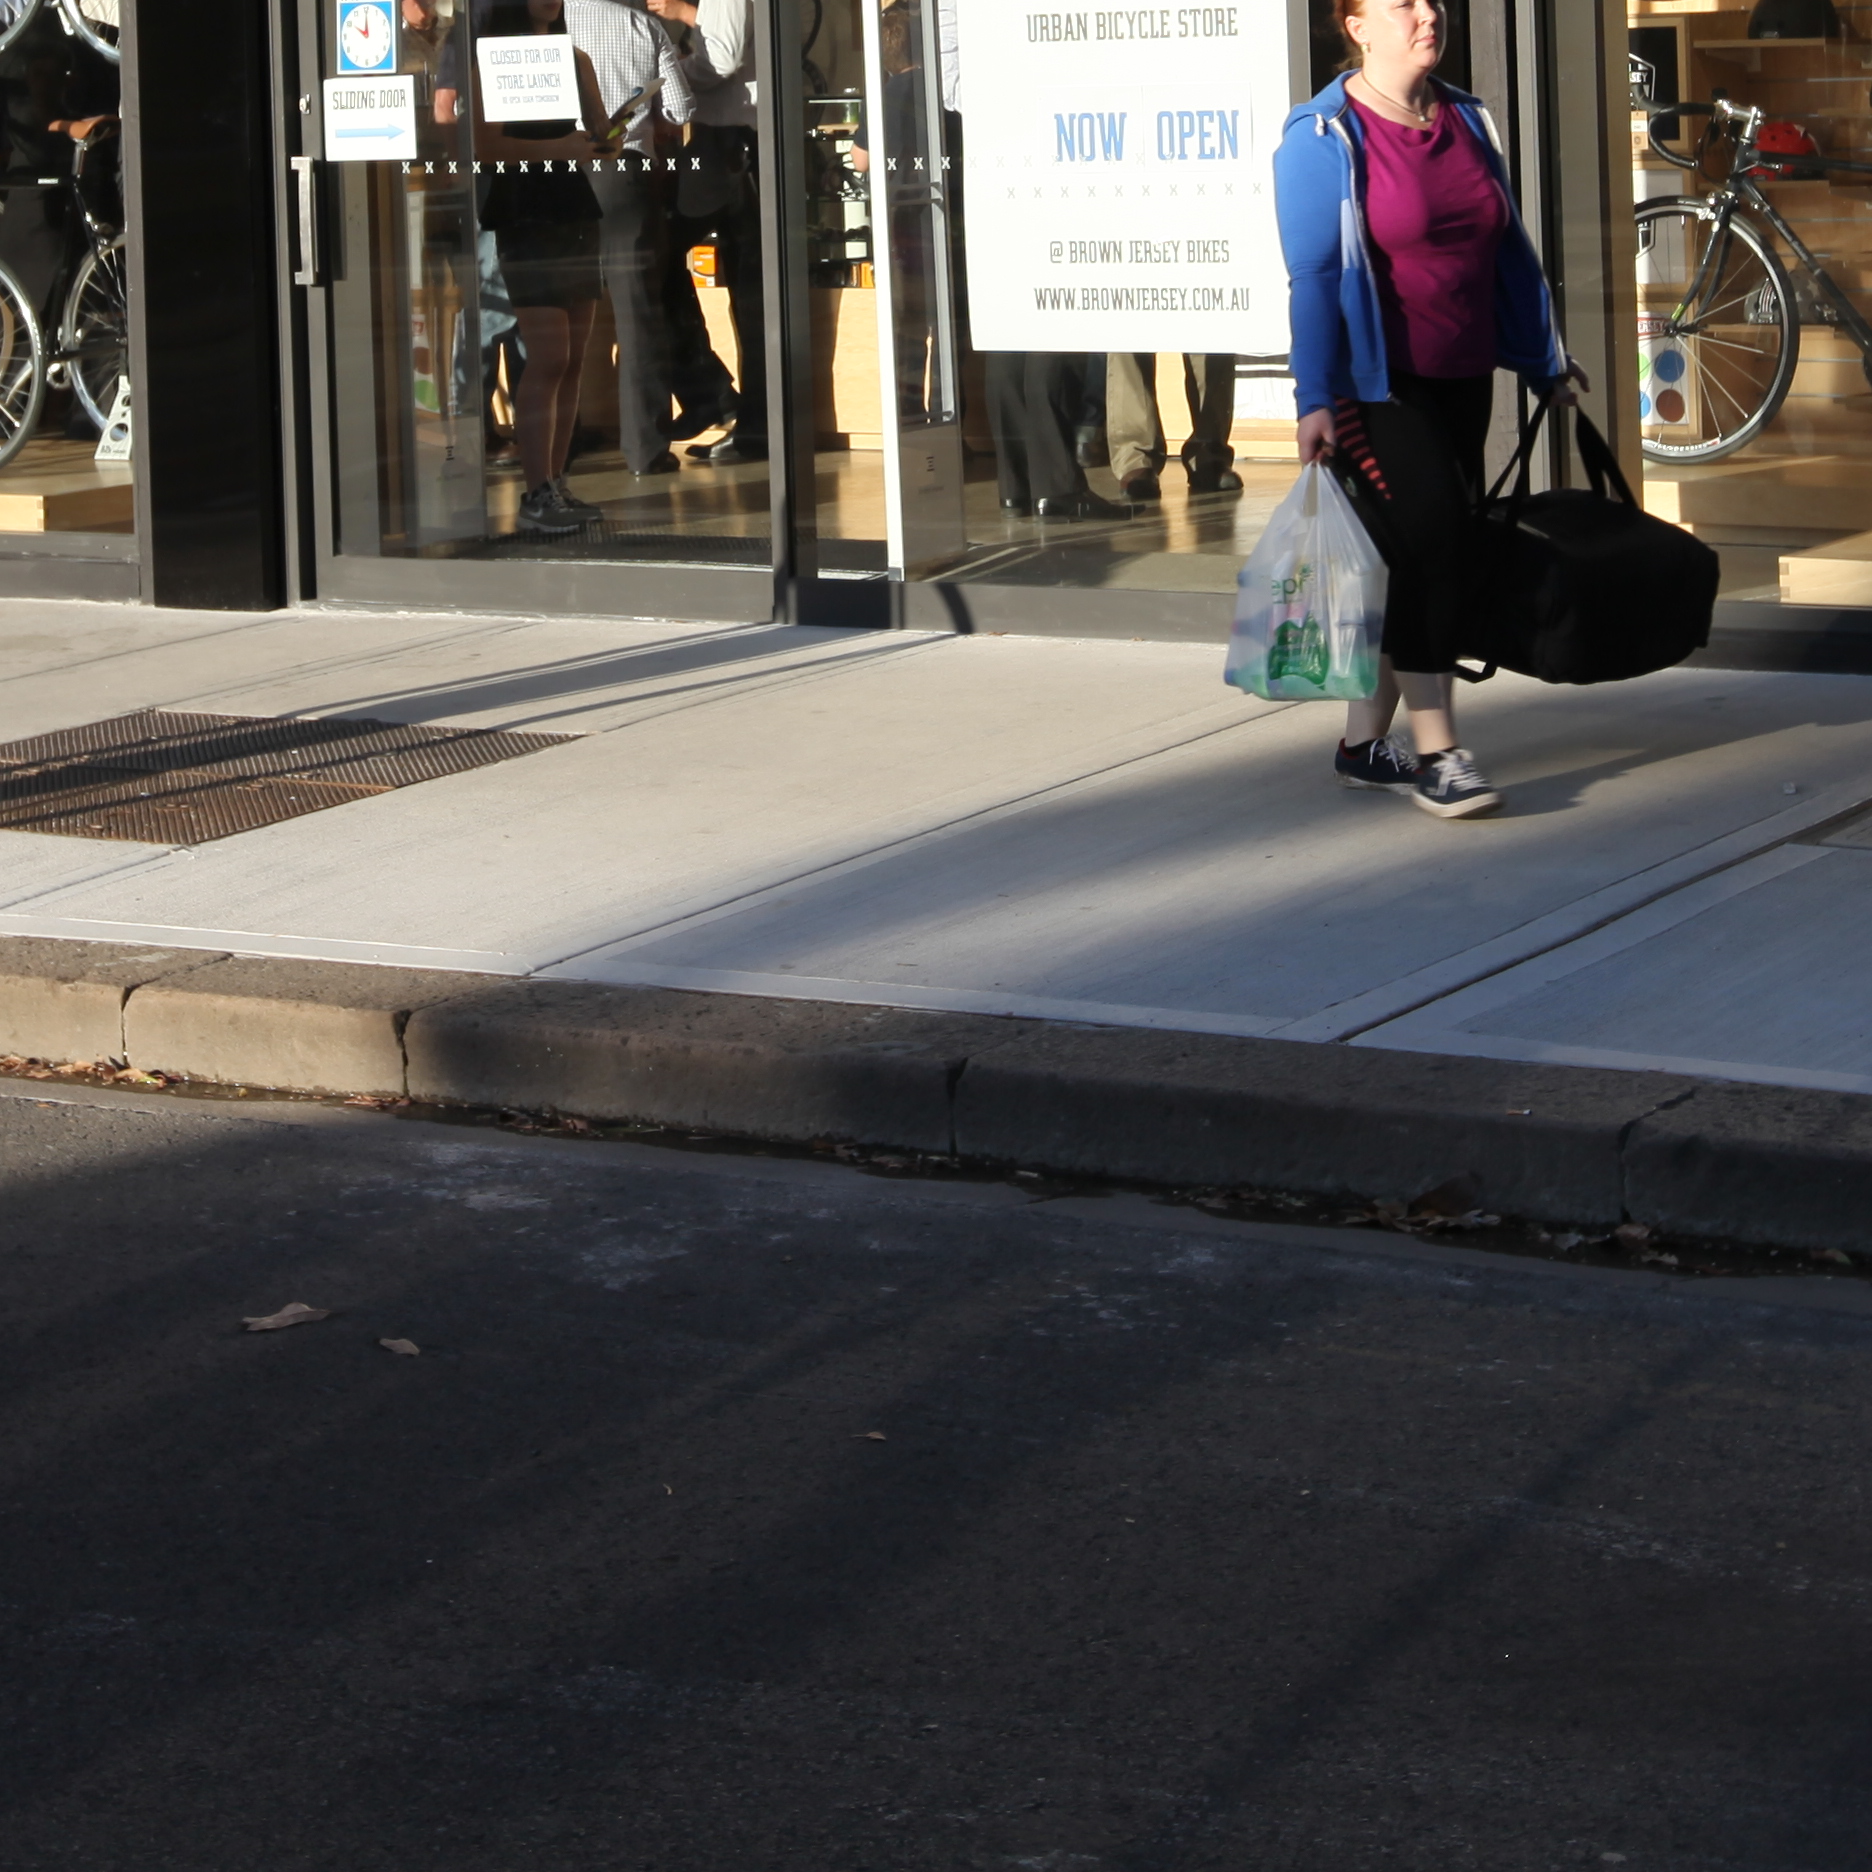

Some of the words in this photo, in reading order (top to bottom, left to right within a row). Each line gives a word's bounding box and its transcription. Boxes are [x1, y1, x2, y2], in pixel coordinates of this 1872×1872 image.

[1026, 13, 1088, 42] URBAN
[1096, 10, 1170, 40] BICYCLE
[1178, 7, 1238, 37] STORE
[490, 50, 522, 65] CLOSED
[524, 49, 541, 64] FOR
[543, 48, 561, 63] OUR
[496, 74, 525, 90] STORE
[526, 73, 562, 89] LAUNCH
[333, 90, 375, 110] SLIDING
[379, 89, 407, 108] DOOR
[1054, 112, 1127, 161] NOW
[1157, 110, 1239, 160] OPEN
[1049, 241, 1063, 263] @
[1069, 240, 1123, 263] BROWN
[1128, 240, 1181, 263] JERSEY
[1187, 240, 1230, 263] BIKES
[1034, 288, 1250, 311] WWW.BROWNJERSEY.COM.AU
